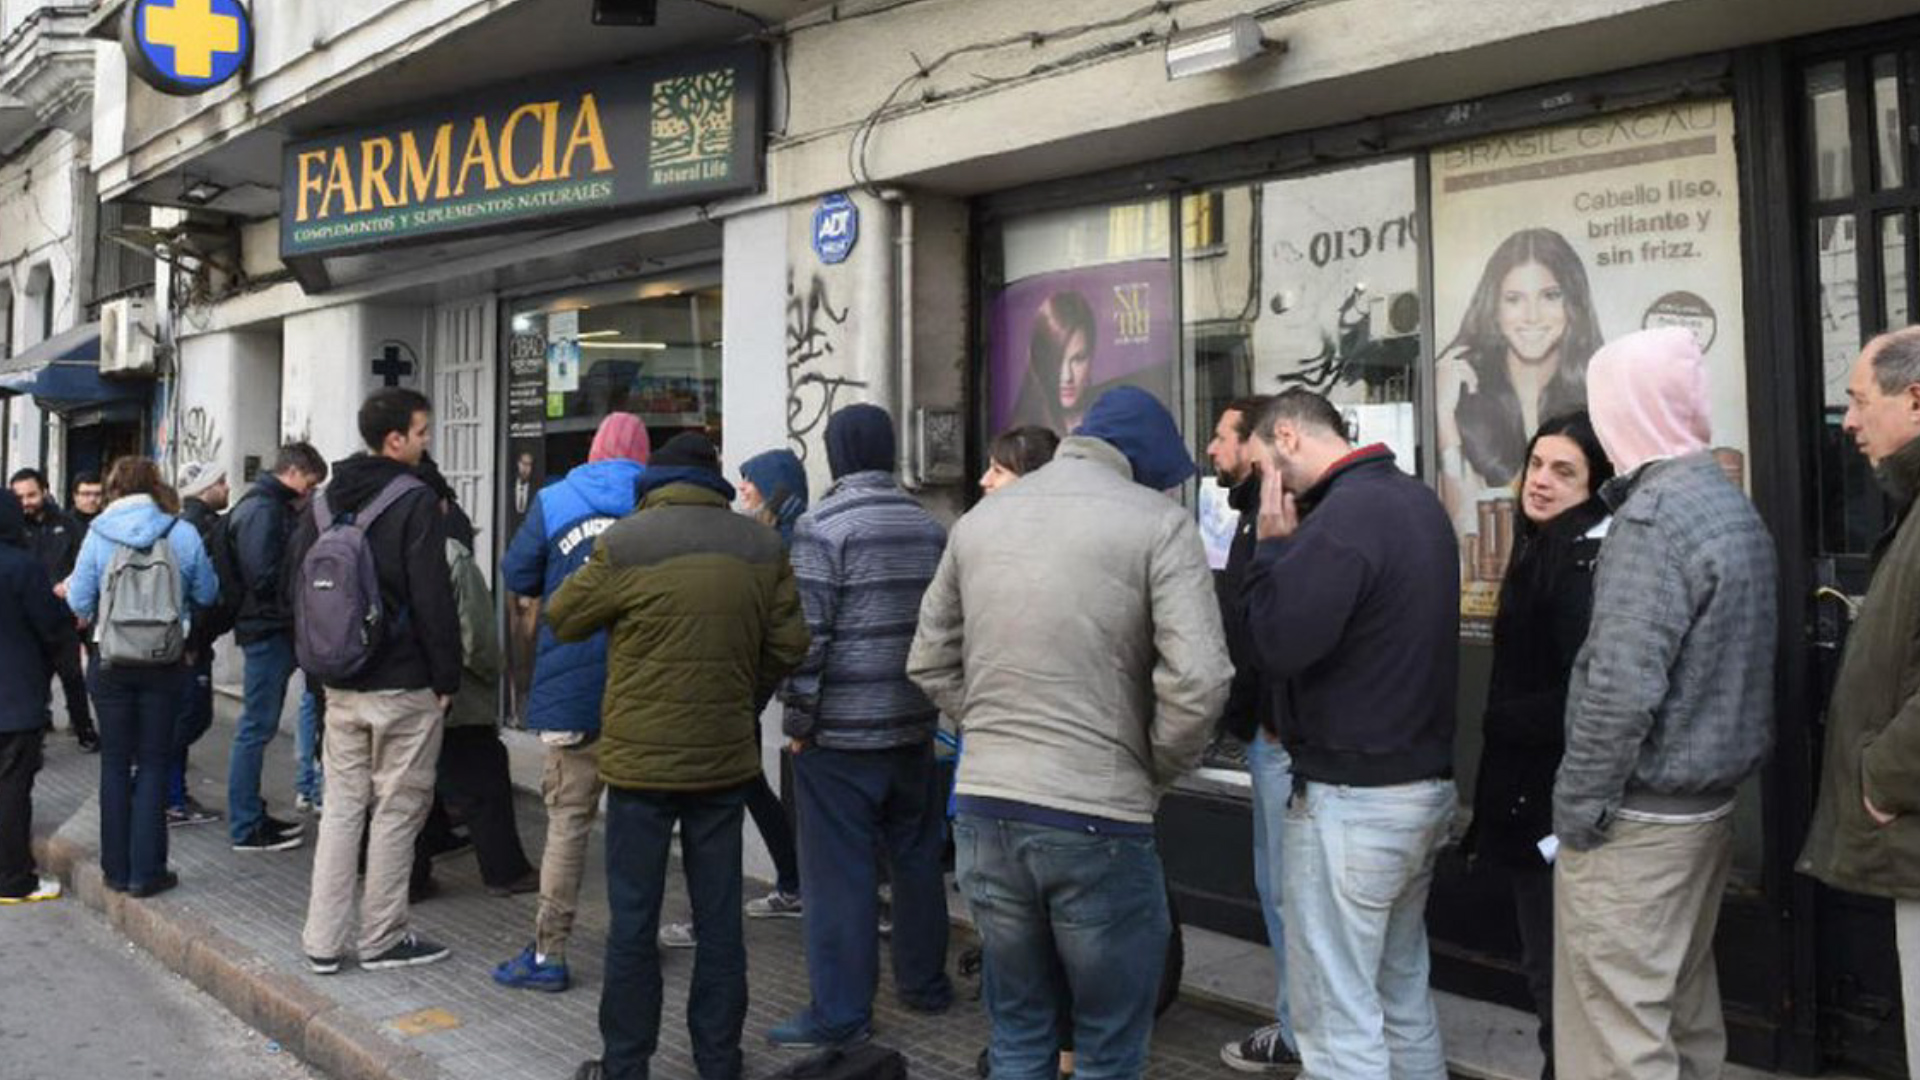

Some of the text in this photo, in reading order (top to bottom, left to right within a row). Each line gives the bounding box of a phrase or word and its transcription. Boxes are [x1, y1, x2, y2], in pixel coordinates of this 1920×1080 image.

[295, 92, 614, 222] FARMACIA
[653, 159, 728, 183] Natural Life
[1575, 179, 1722, 212] Cabello liso,
[294, 181, 612, 242] COMPLEMENTOS Y SUPLEMENTOS NATURALES
[819, 210, 850, 238] ADT
[1588, 209, 1712, 239] brillante y
[1596, 239, 1702, 266] sin frizz.
